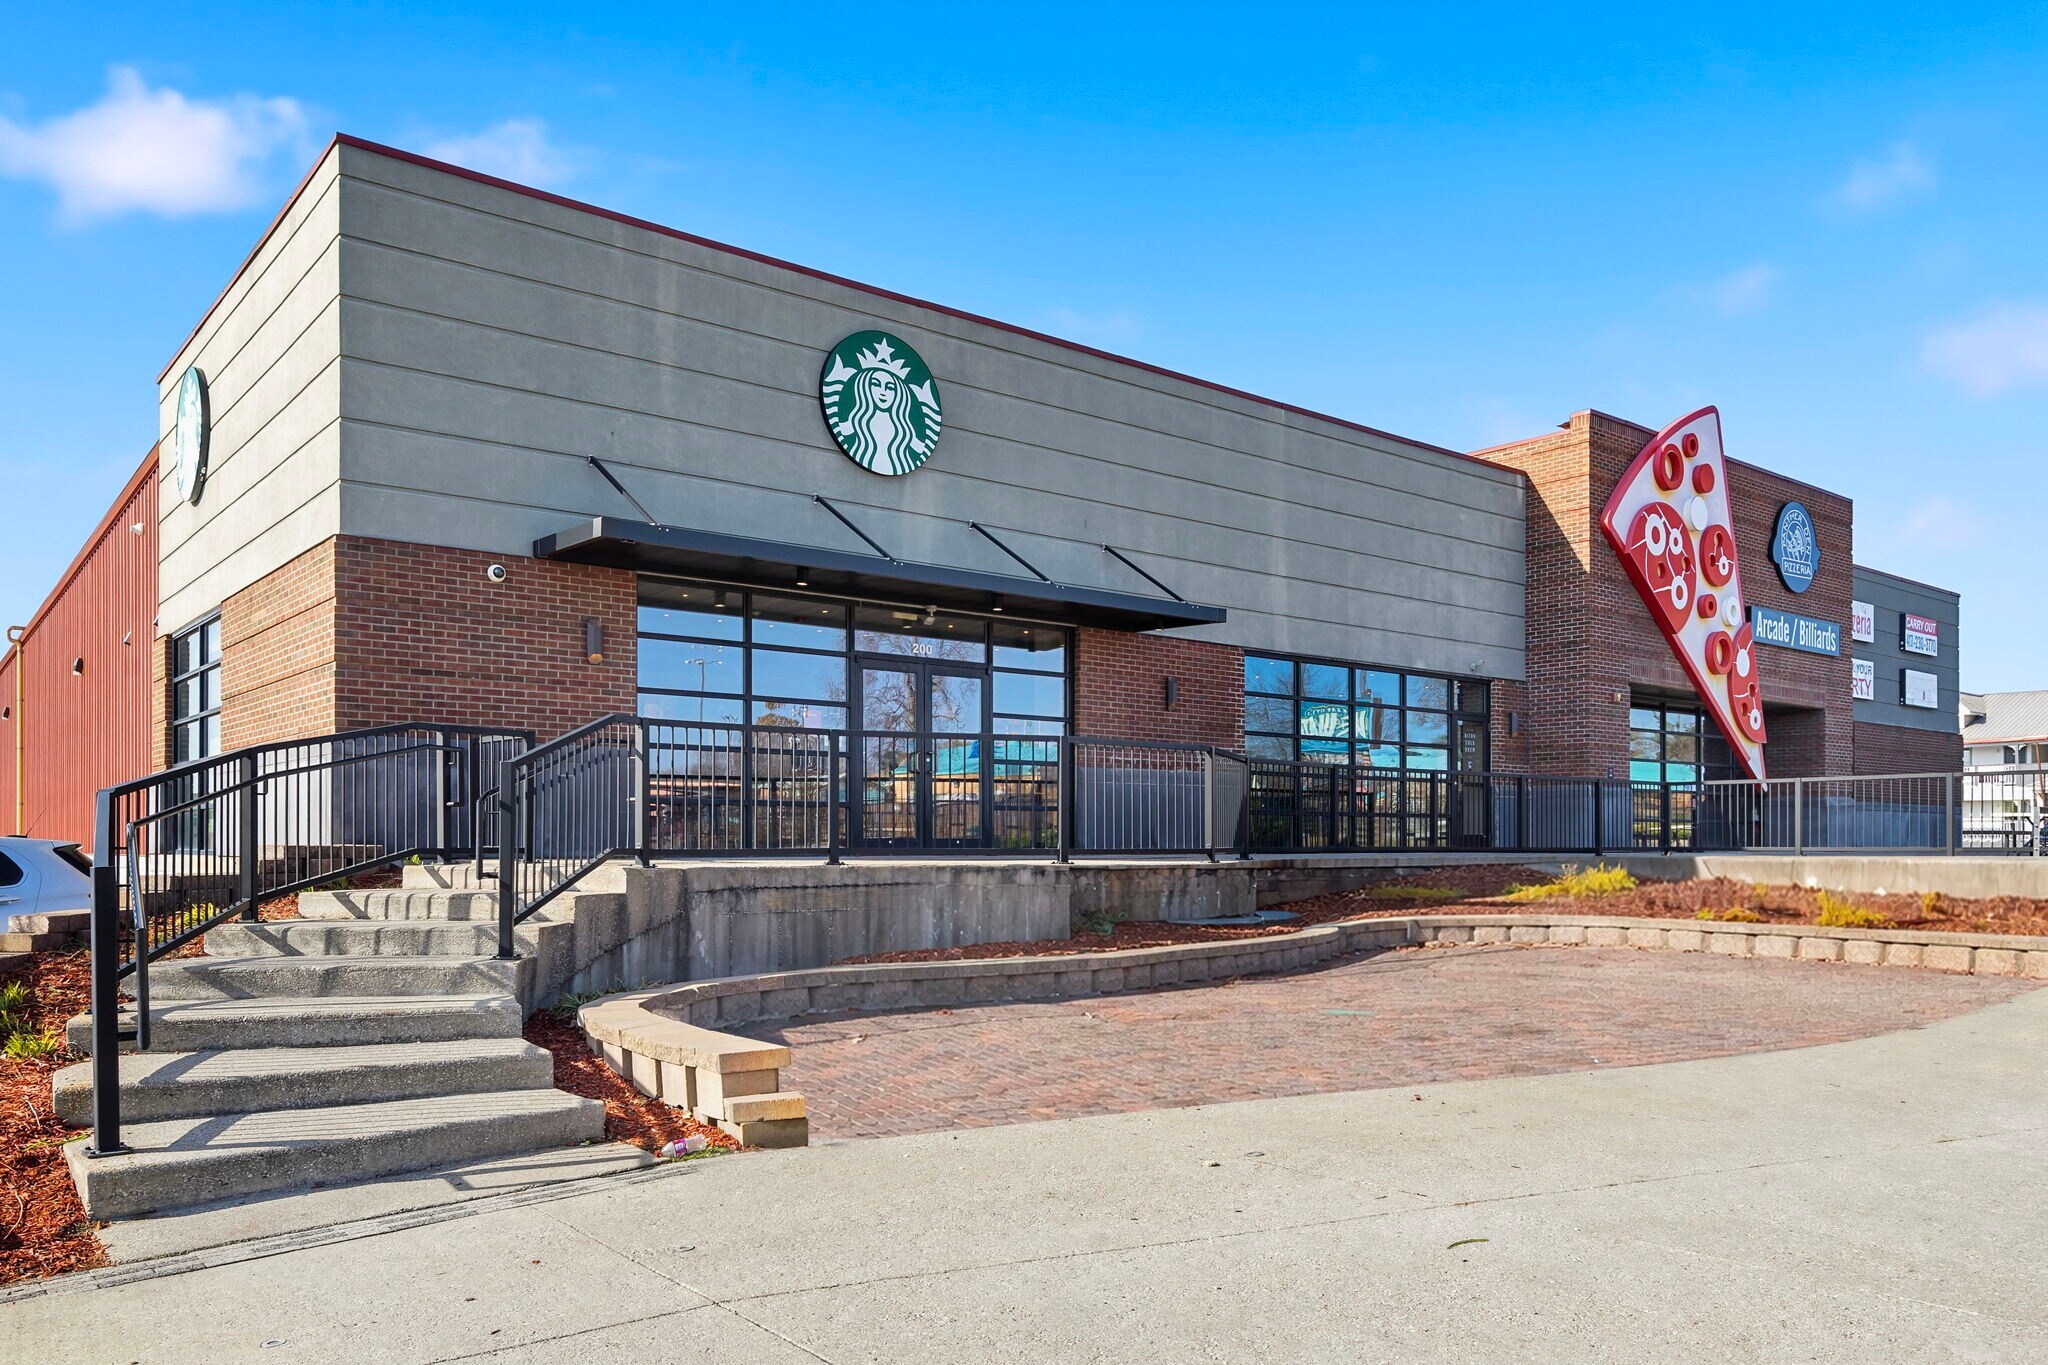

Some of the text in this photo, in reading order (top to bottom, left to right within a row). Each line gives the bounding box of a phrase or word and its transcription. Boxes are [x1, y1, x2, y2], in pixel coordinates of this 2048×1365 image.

[1782, 512, 1803, 547] PANTHER
[1784, 561, 1811, 575] PIZZERIA
[1756, 611, 1836, 652] Arcade / Billiards
[1906, 617, 1937, 634] CARRY OUT
[912, 643, 932, 655] 200
[1856, 663, 1873, 675] YOUR
[1852, 677, 1872, 697] RTY
